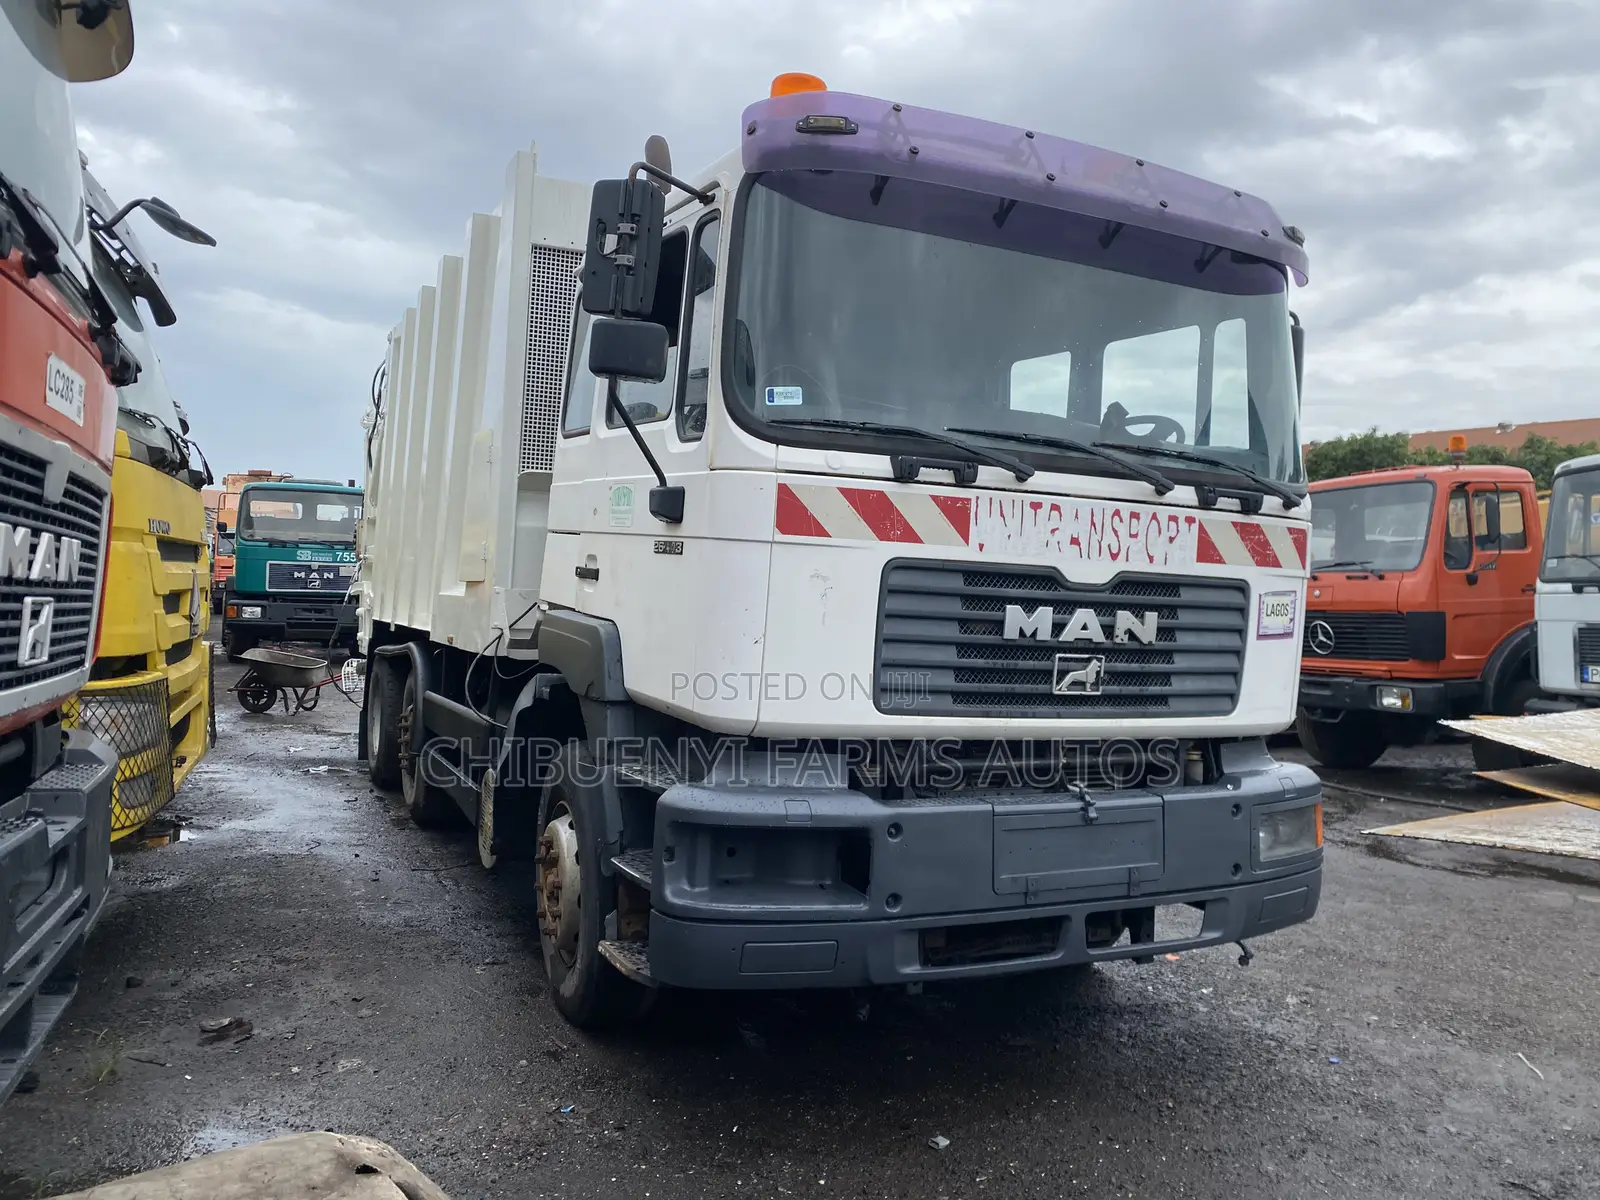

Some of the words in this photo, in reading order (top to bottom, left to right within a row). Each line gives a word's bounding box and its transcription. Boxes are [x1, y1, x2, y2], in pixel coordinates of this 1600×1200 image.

[48, 363, 74, 405] LC285
[0, 521, 82, 582] MAN
[335, 551, 357, 562] 755
[293, 571, 334, 579] MAN
[1265, 602, 1290, 617] LAGOS
[1003, 604, 1159, 645] MAN
